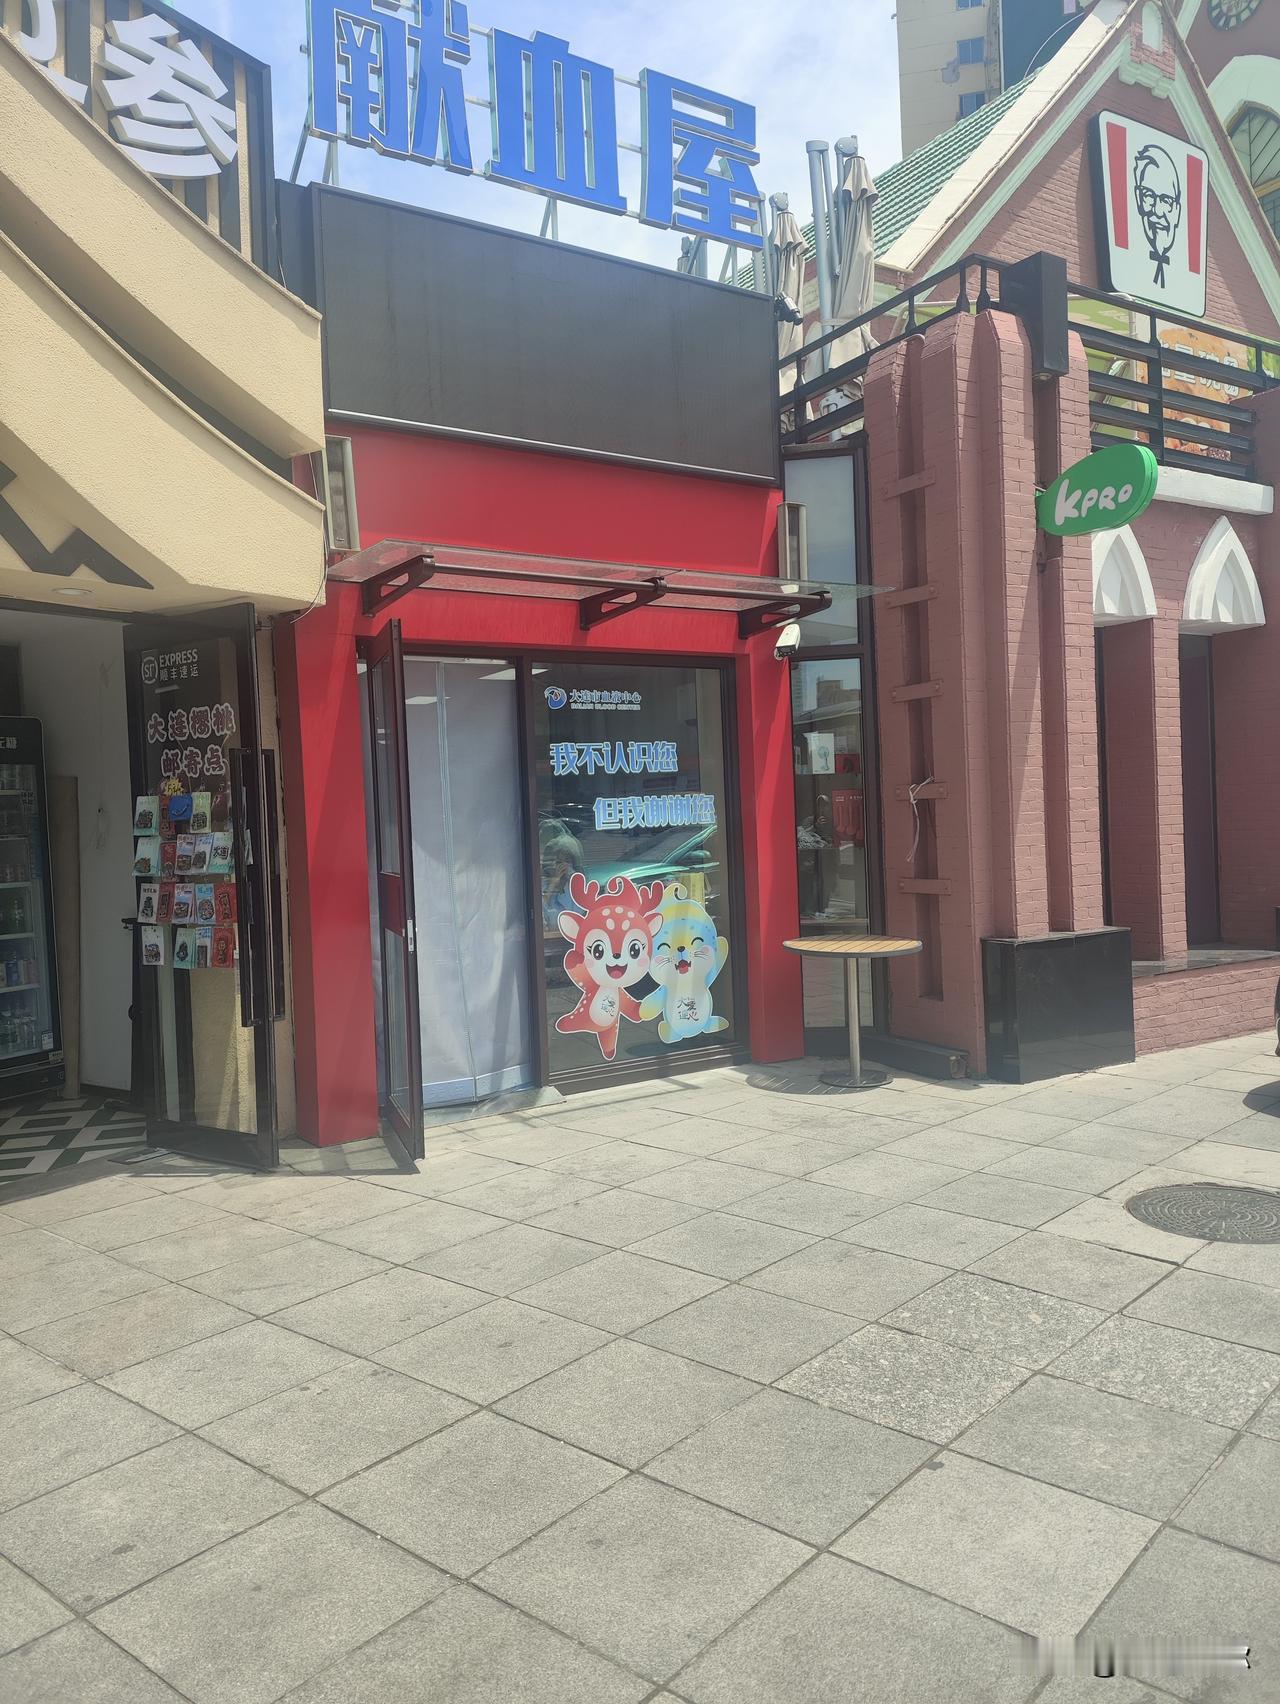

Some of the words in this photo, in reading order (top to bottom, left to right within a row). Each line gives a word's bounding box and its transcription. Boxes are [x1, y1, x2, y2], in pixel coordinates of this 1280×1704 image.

[308, 0, 763, 252] 献血屋
[1055, 478, 1133, 526] KPRO
[160, 649, 198, 667] EXPRESS
[160, 664, 199, 681] 顺丰速运
[569, 689, 642, 703] 大连市血液中心
[161, 744, 226, 777] 邮寄点
[550, 741, 678, 776] 我不认识您
[593, 793, 717, 831] 但我谢谢您
